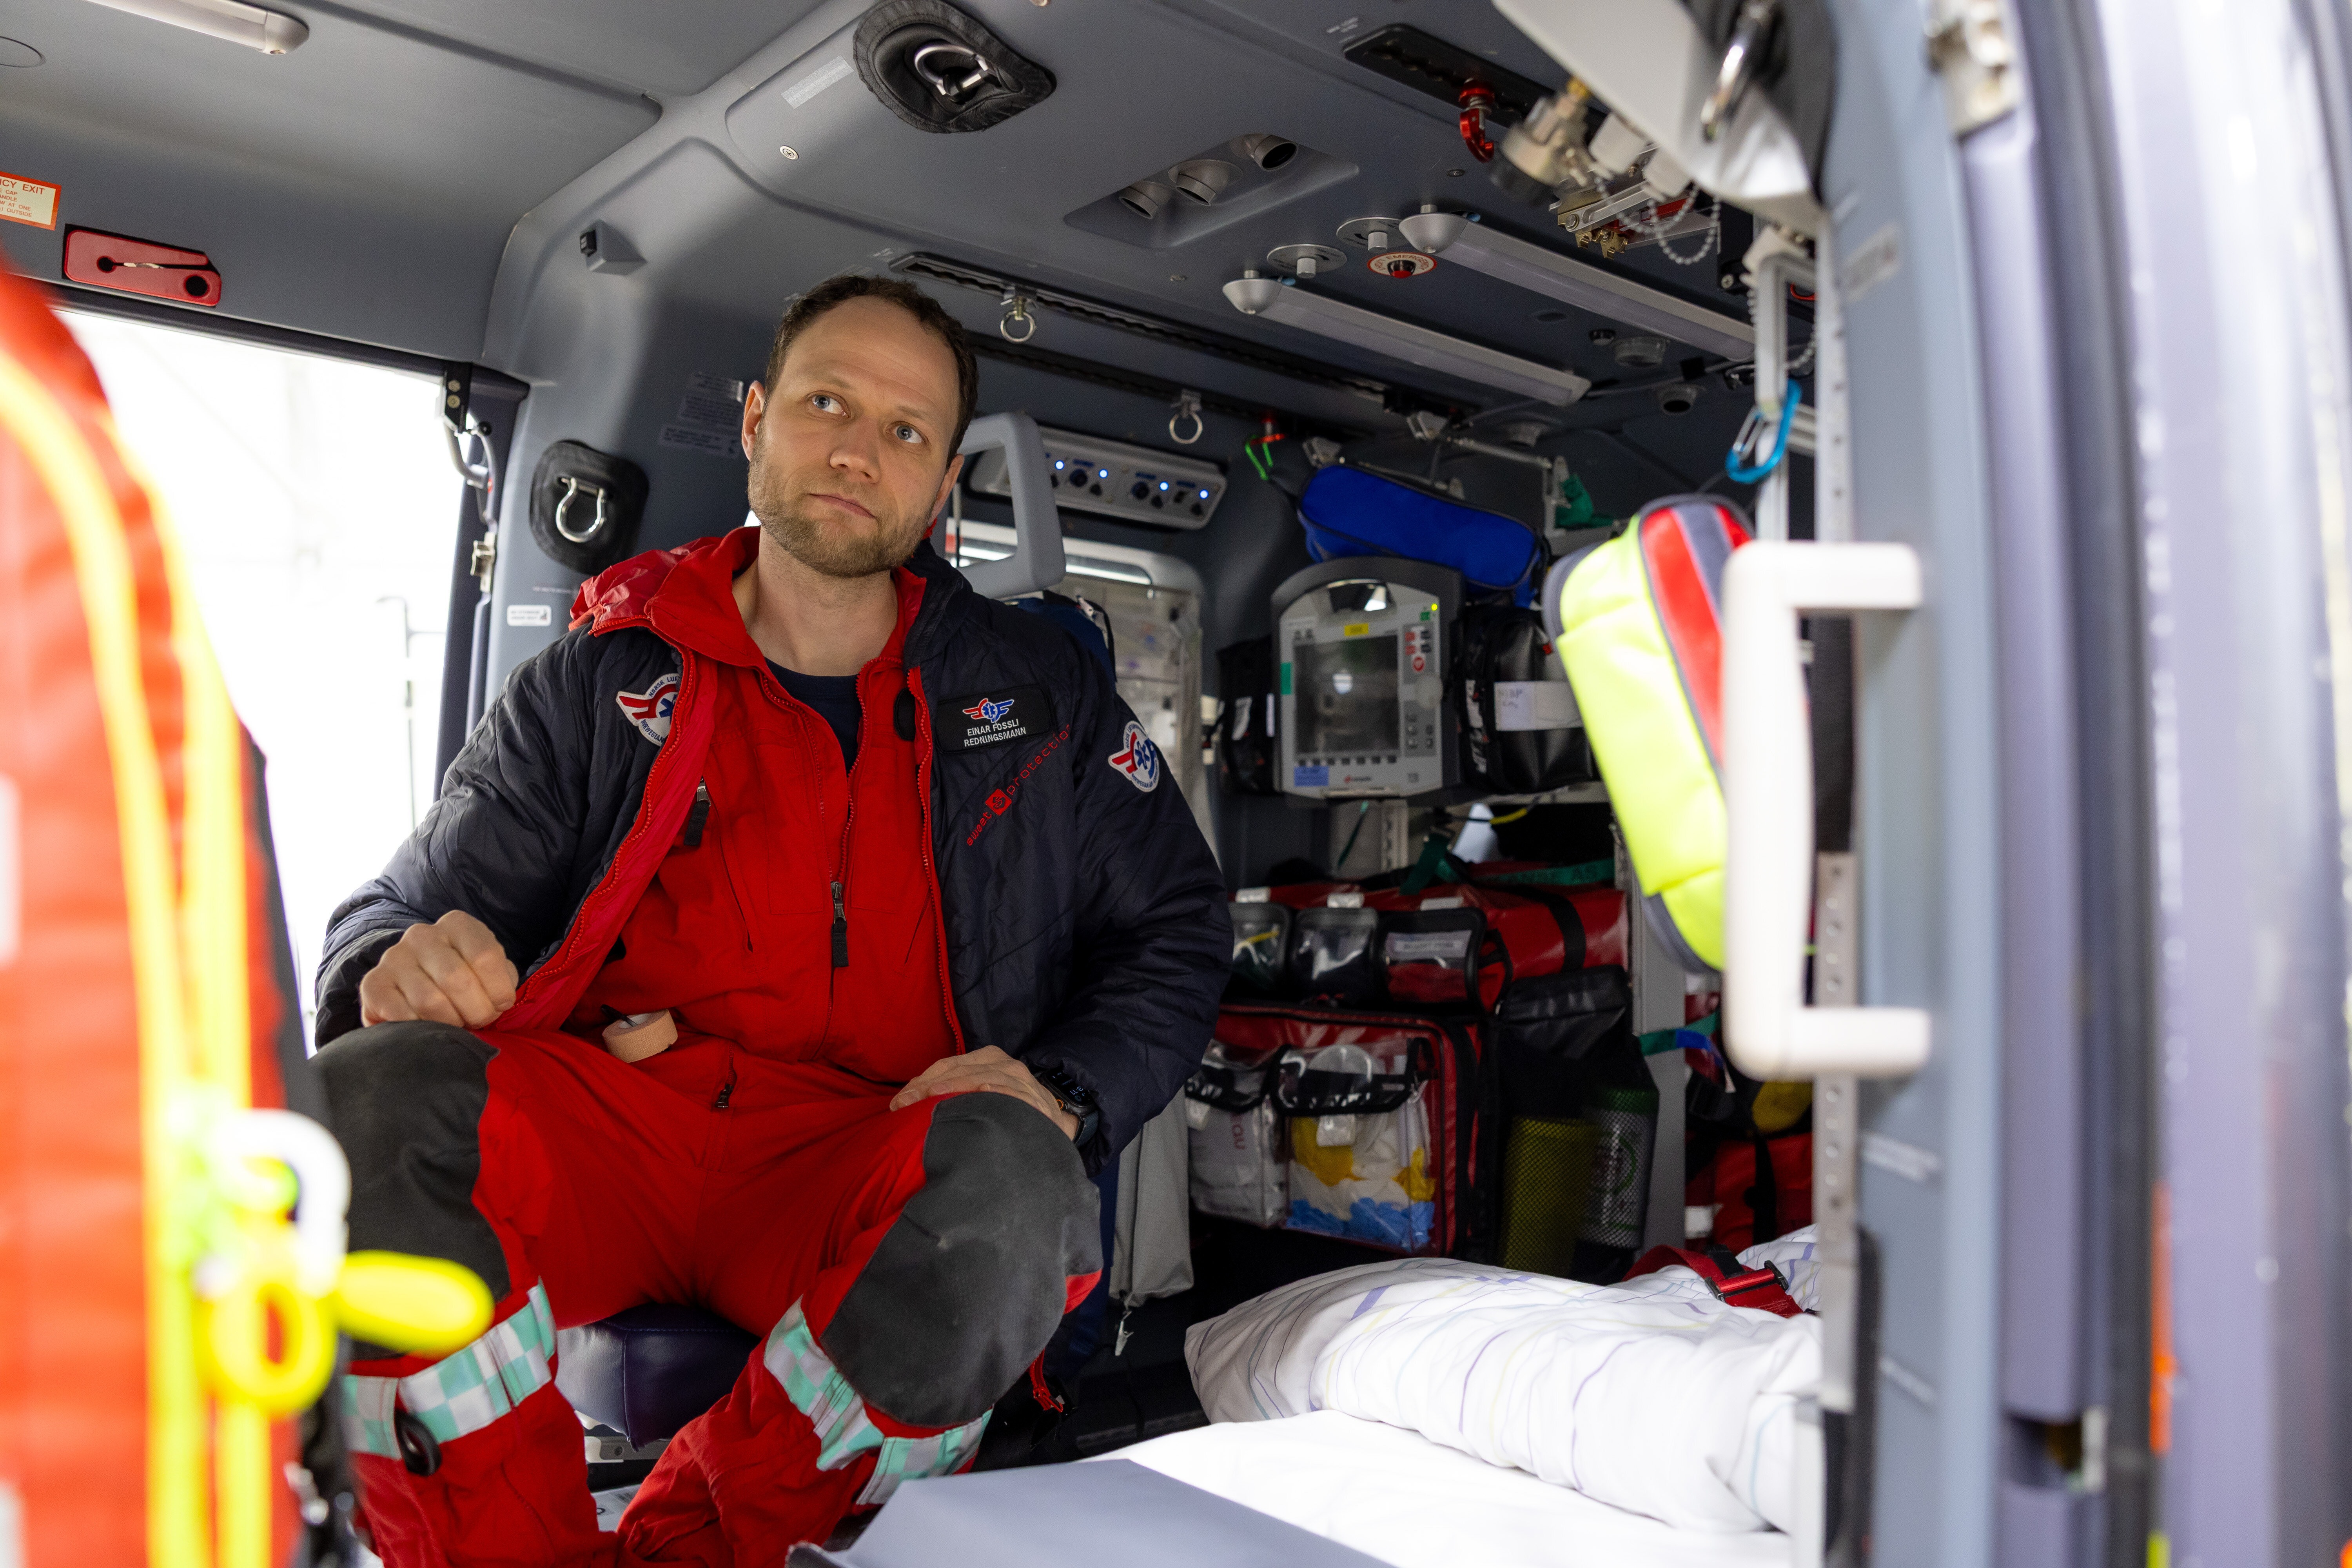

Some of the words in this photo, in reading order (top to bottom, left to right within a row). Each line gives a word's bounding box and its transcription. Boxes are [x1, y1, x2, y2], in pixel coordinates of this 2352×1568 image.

[22, 183, 45, 194] EXIT
[7, 208, 32, 217] OUTSIDE
[1385, 255, 1429, 270] EMERGENCY
[649, 680, 665, 697] NORSK
[641, 719, 664, 744] NORWEGIAN
[967, 726, 991, 736] EINAR
[993, 719, 1019, 731] FOSSLI
[964, 727, 1026, 747] REDNINGSMANN
[967, 811, 992, 846] sweet
[1070, 1086, 1083, 1095] 3:11
